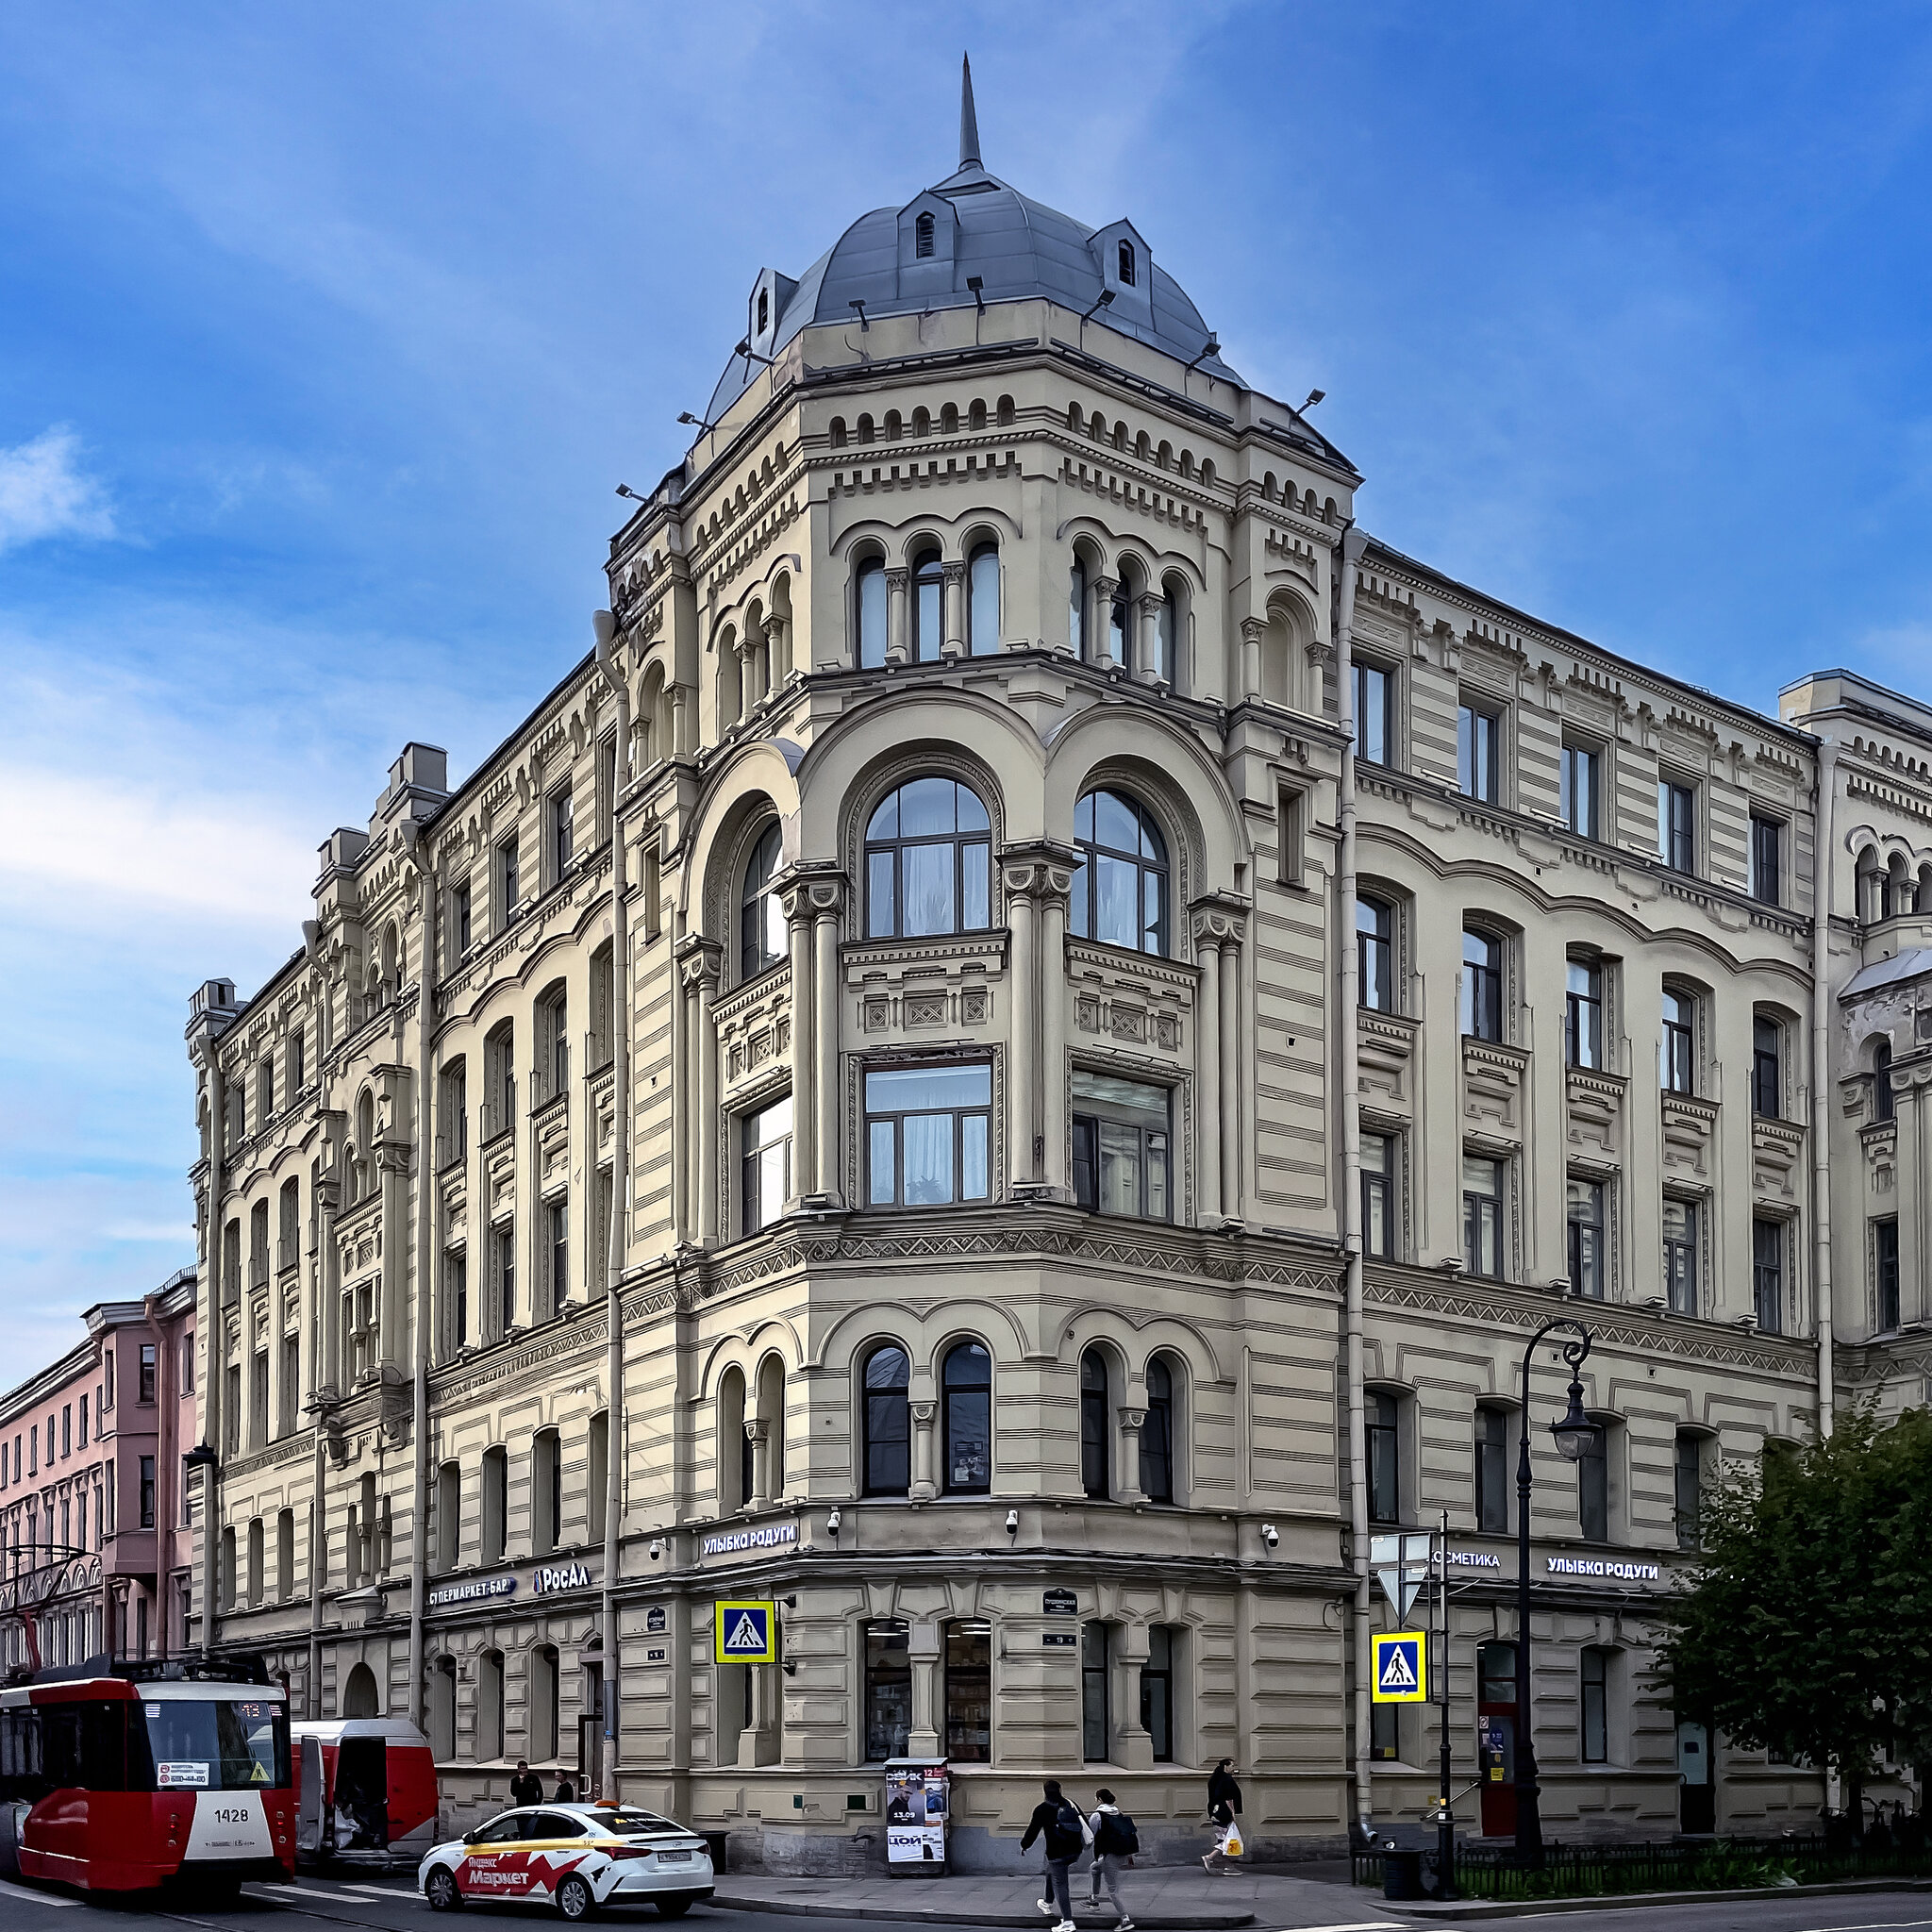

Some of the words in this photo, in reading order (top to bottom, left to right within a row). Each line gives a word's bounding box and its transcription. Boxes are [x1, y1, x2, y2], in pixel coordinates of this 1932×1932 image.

[214, 1809, 249, 1823] 1428
[889, 1835, 921, 1846] ЦОЙ
[468, 1870, 529, 1887] Маркет
